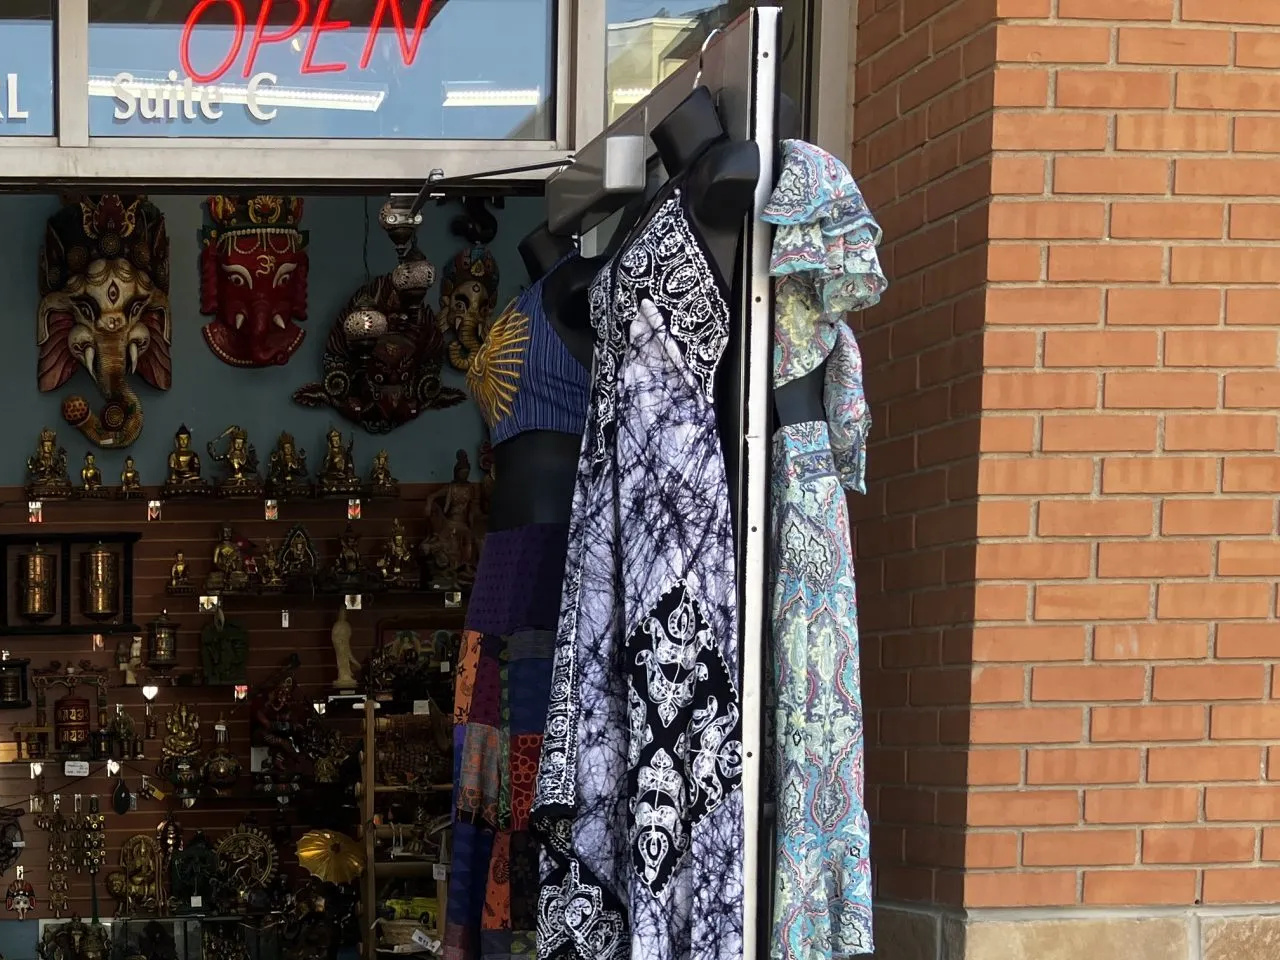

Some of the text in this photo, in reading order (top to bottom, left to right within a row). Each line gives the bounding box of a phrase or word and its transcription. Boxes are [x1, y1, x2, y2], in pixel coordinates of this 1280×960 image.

[179, 0, 433, 83] OPEN
[114, 70, 278, 121] Suite C
